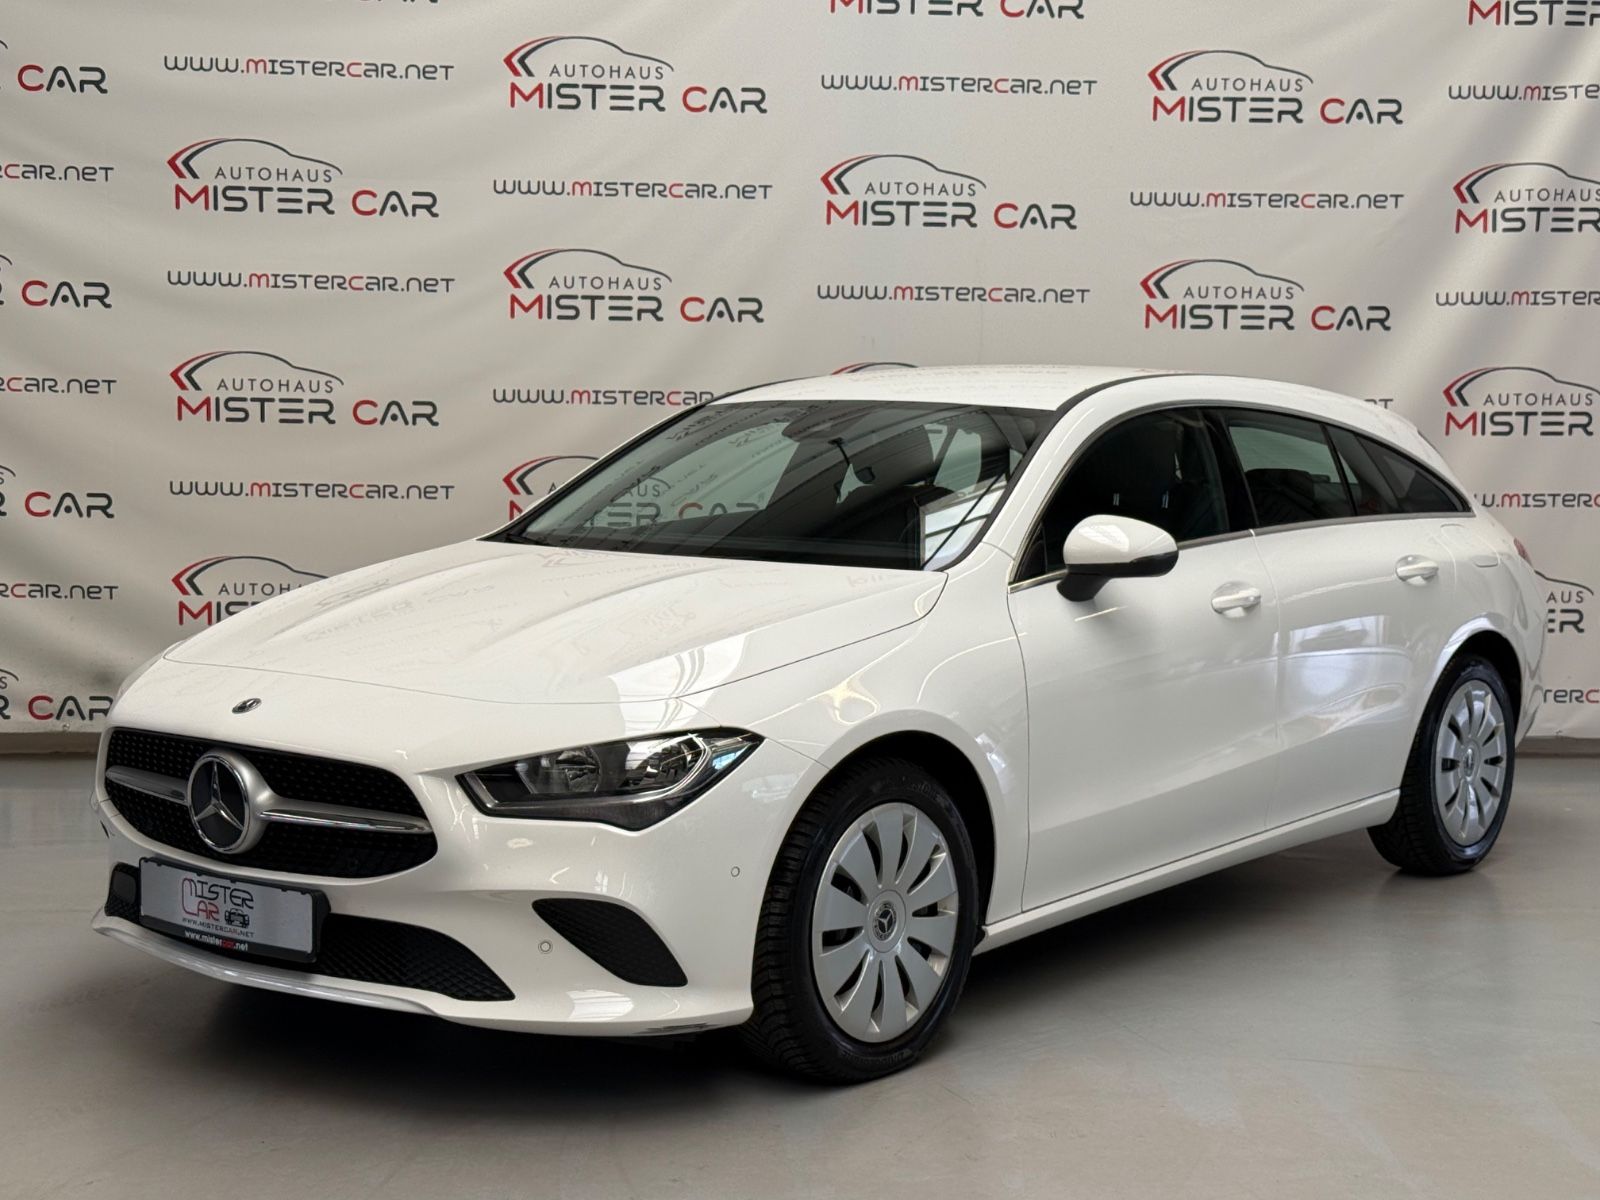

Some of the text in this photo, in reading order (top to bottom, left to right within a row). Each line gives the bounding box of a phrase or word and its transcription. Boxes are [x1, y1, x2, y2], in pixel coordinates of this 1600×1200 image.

[18, 65, 108, 94] CAR
[549, 64, 664, 80] AUTOHAUS
[1192, 78, 1304, 92] AUTOHAUS
[510, 83, 767, 114] MISTER CAR
[1153, 96, 1403, 125] MISTER CAR
[0, 164, 114, 182] car.net
[215, 166, 333, 183] AUTOHAUS
[175, 184, 439, 218] MISTER CAR
[865, 182, 976, 197] AUTOHAUS
[826, 200, 1077, 230] MISTER CAR
[22, 280, 112, 309] CAR
[549, 276, 662, 291] AUTOHAUS
[1184, 286, 1294, 300] AUTOHAUS
[510, 294, 764, 323] MISTER CAR
[1145, 304, 1391, 331] MISTER CAR
[217, 378, 334, 393] AUTOHAUS
[177, 396, 439, 426] MISTER CAR
[1484, 393, 1593, 406] AUTOHAUS
[1445, 411, 1594, 436] MISTER
[25, 492, 114, 518] CAR
[219, 583, 290, 596] AUTOH
[182, 878, 254, 910] MISTER
